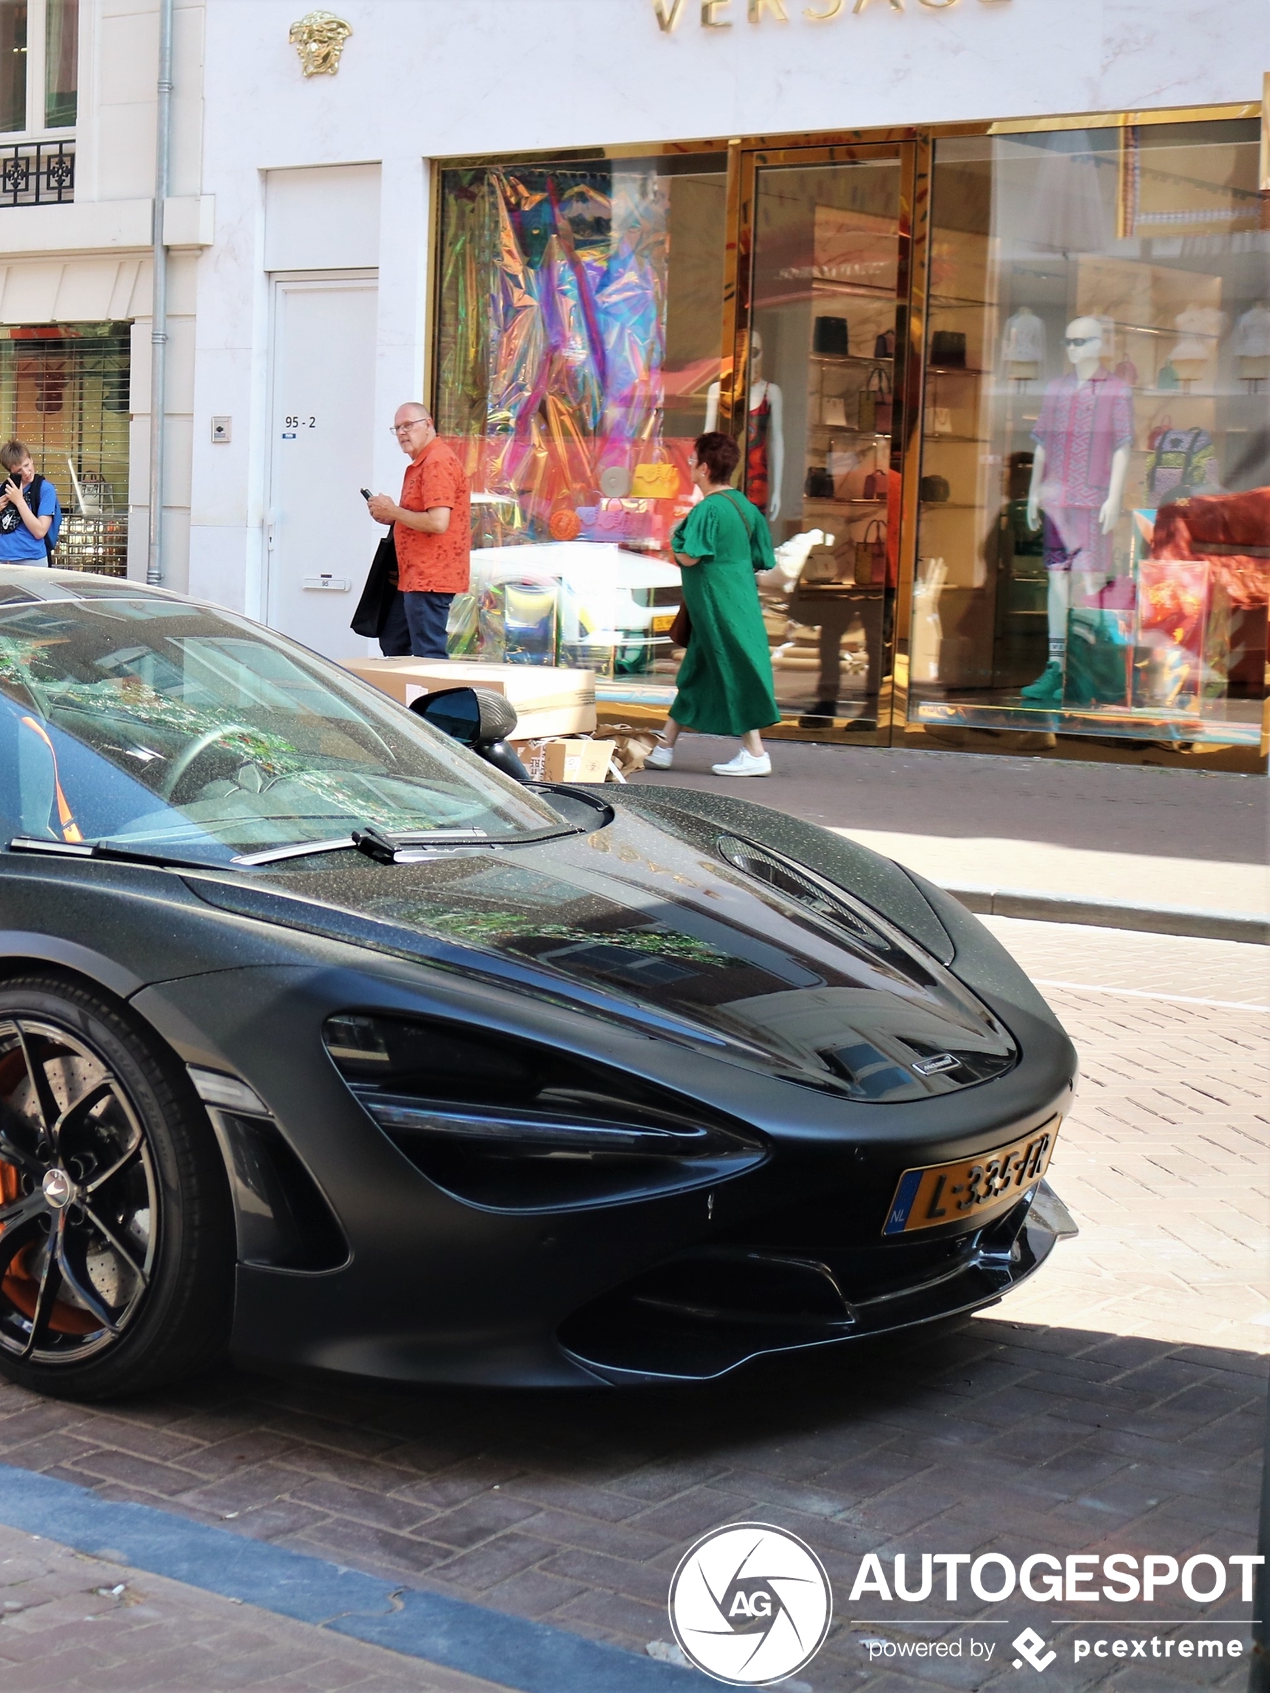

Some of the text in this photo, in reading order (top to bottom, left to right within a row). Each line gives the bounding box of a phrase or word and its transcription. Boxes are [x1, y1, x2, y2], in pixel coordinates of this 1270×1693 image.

[285, 416, 299, 428] 95
[309, 416, 316, 428] 2
[889, 1209, 905, 1223] NL
